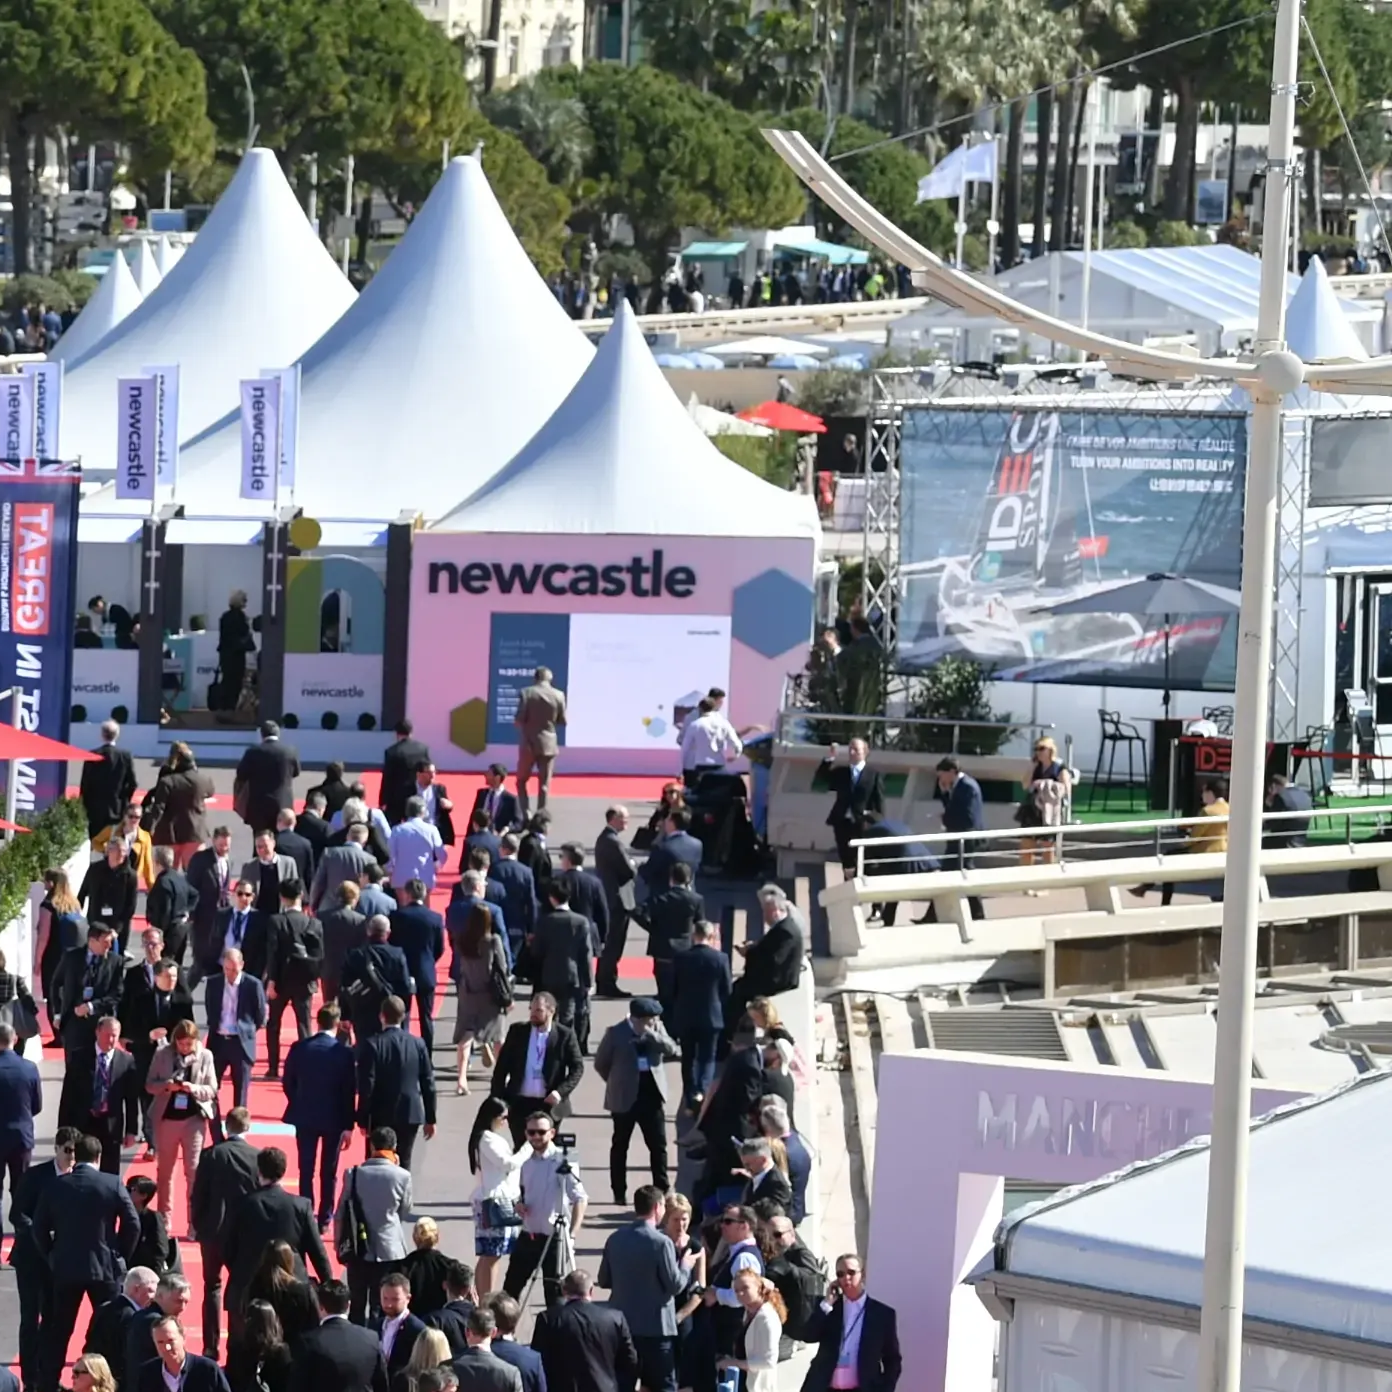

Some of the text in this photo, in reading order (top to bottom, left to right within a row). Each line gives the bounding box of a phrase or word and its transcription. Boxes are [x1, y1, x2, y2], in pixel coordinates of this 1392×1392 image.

[127, 386, 147, 491] newcastle
[251, 387, 269, 492] newcastle
[1121, 457, 1171, 470] AMBITIONS
[1173, 458, 1194, 471] INTO
[428, 548, 697, 598] newcastle
[301, 685, 365, 698] newcastle
